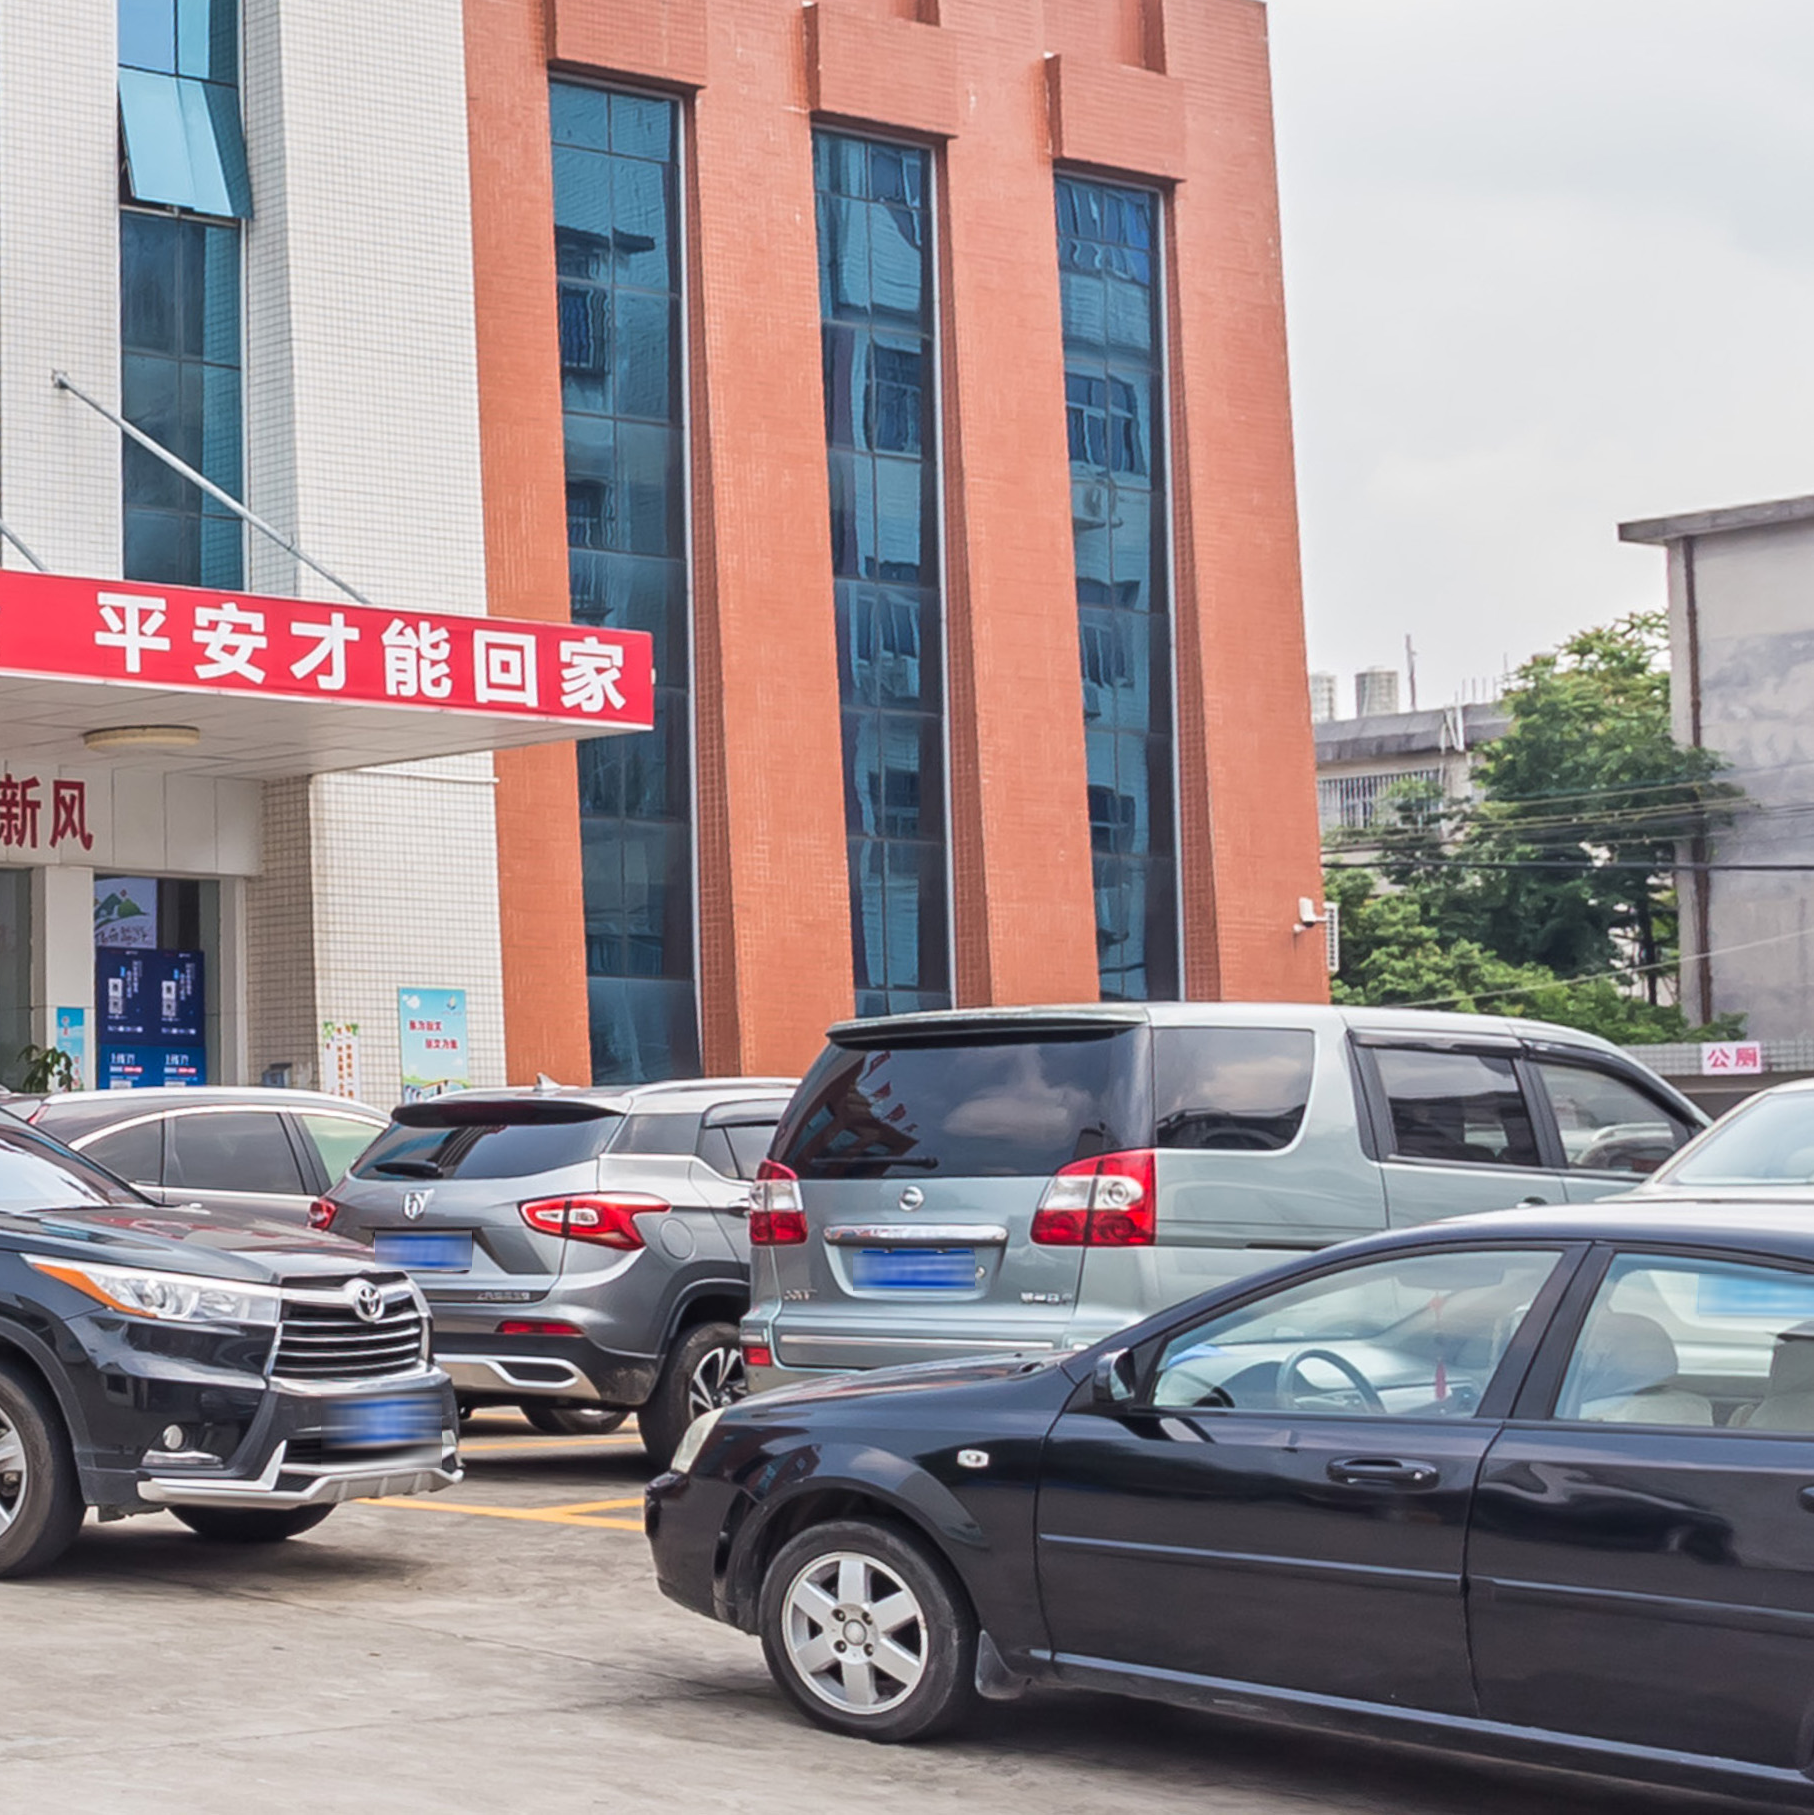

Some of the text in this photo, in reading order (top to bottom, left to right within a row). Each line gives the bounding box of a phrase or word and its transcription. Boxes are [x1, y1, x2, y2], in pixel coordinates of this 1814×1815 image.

[95, 591, 626, 713] 平安才能回家
